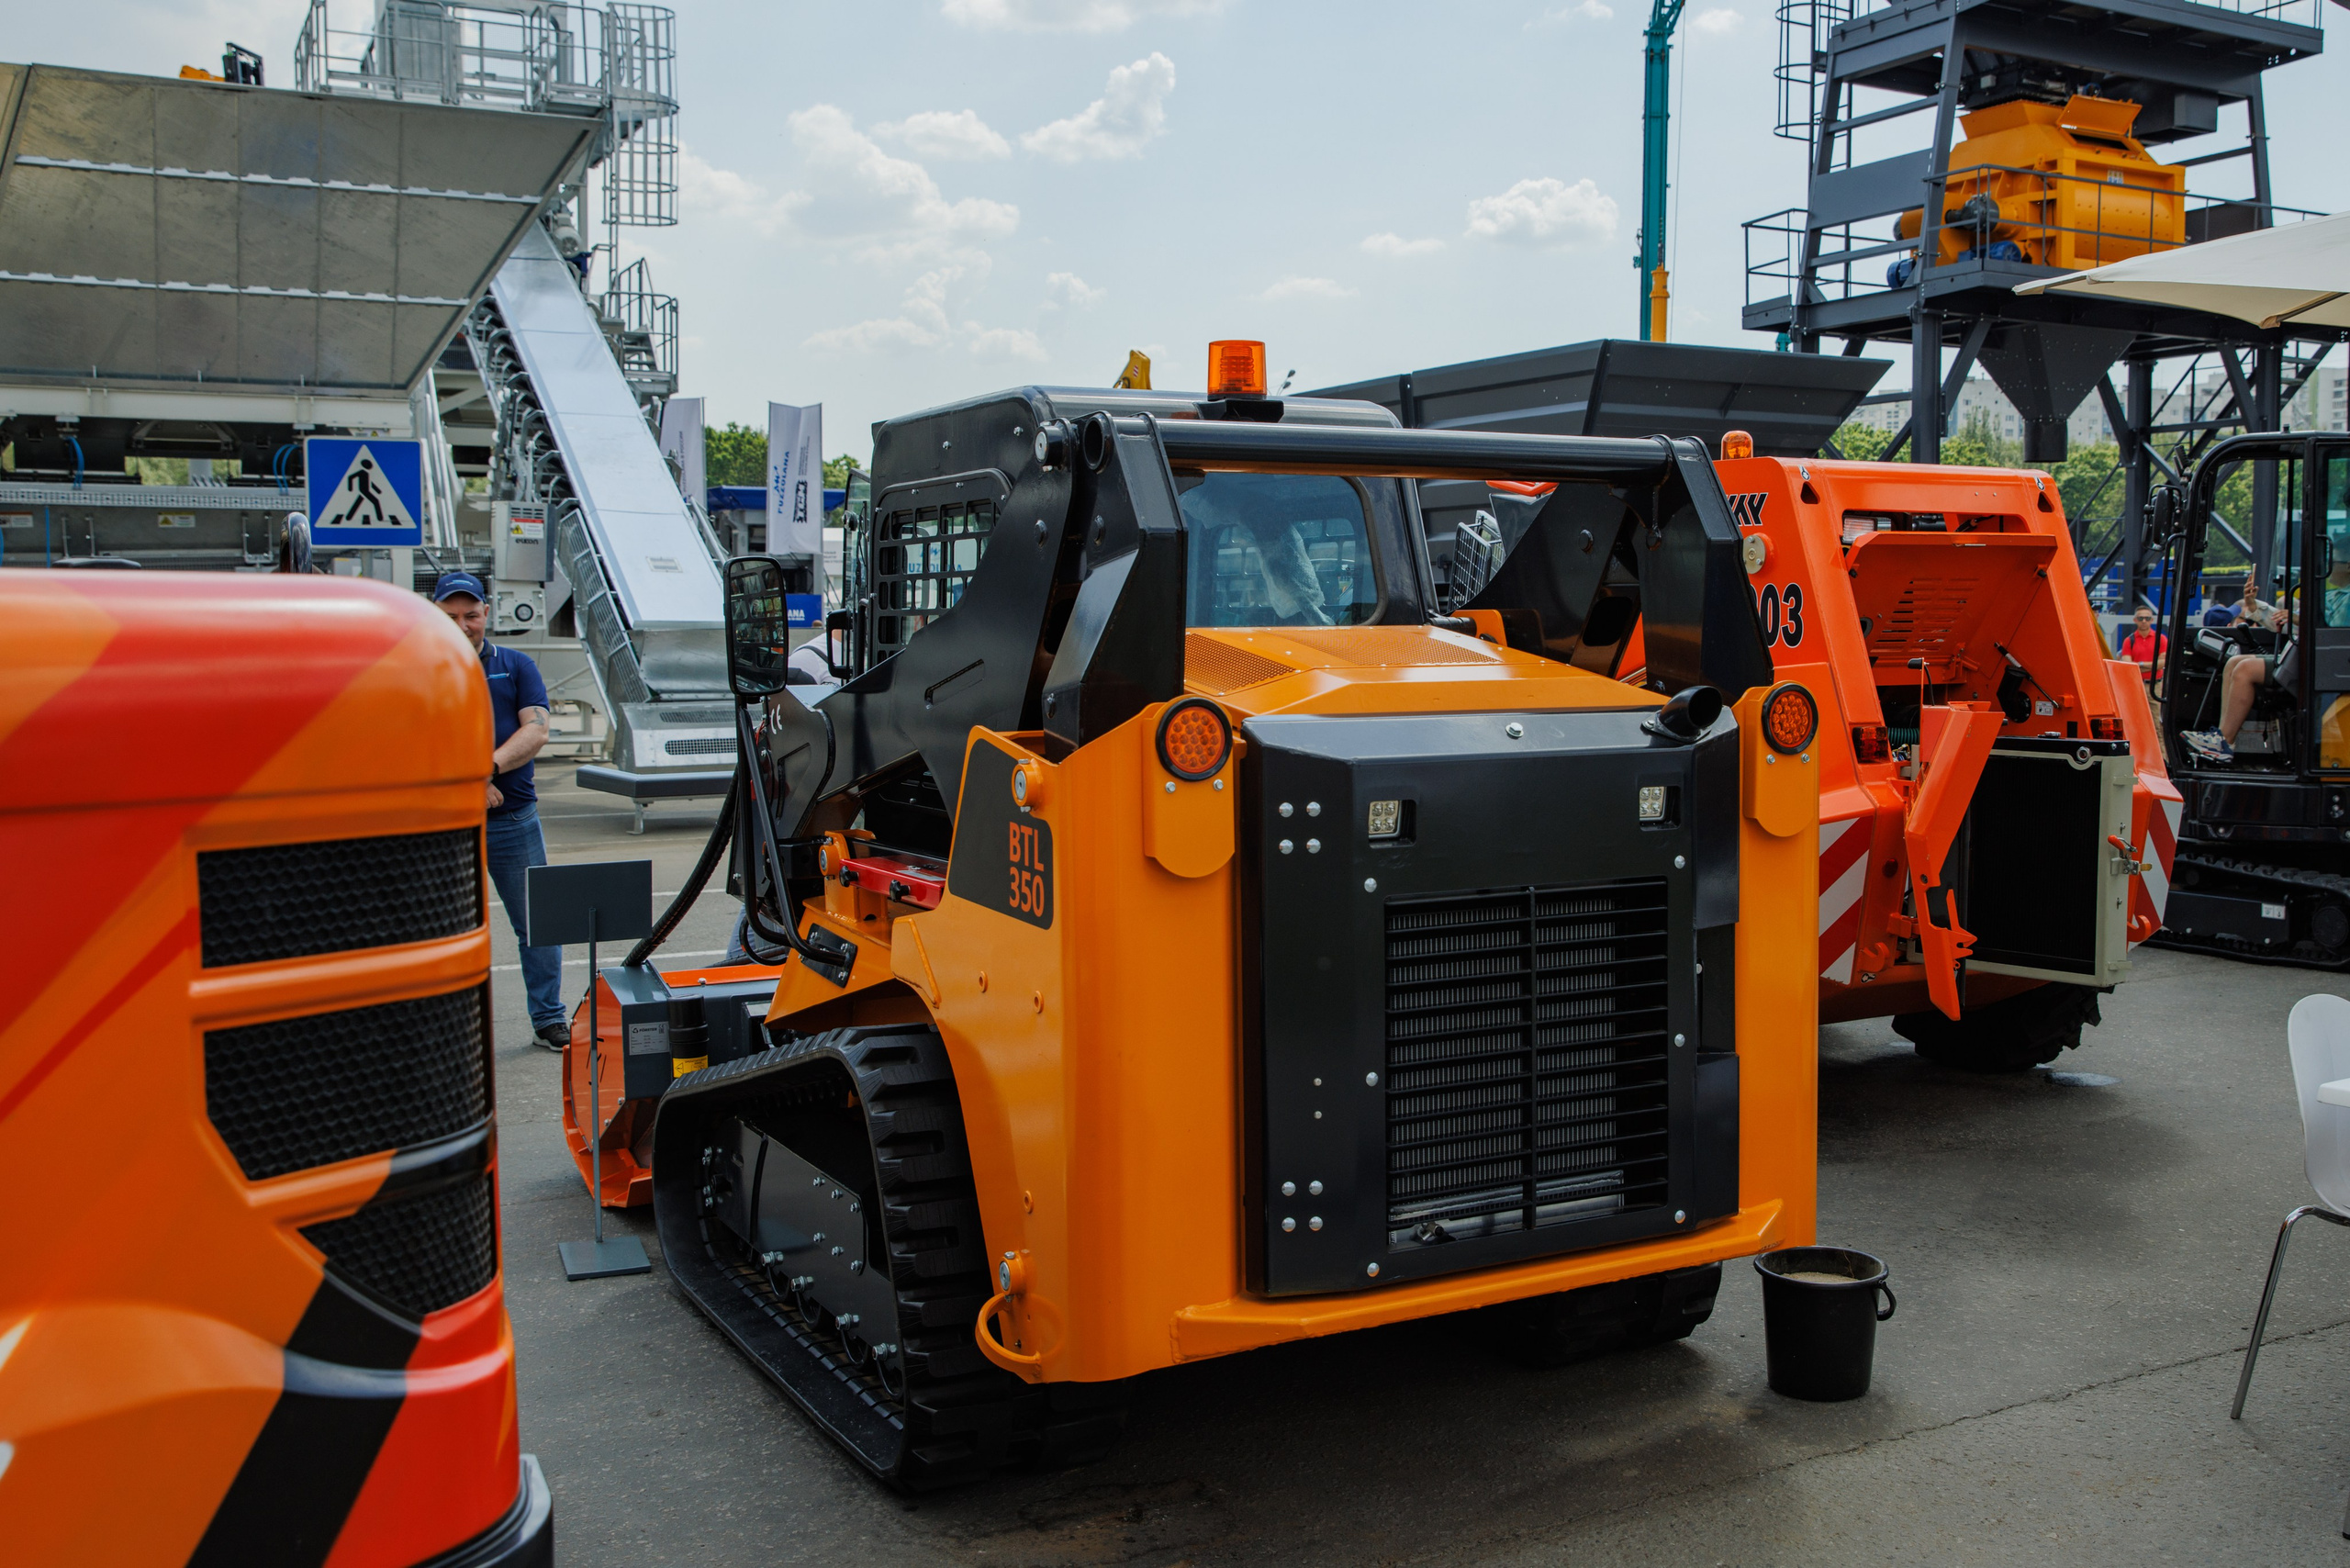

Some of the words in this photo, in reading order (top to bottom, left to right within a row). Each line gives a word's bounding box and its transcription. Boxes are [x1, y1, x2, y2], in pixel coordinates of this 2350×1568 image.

[778, 451, 789, 514] PUZZOLANA
[1750, 583, 1804, 648] 03
[1009, 821, 1045, 872] BTL
[1009, 866, 1045, 918] 350
